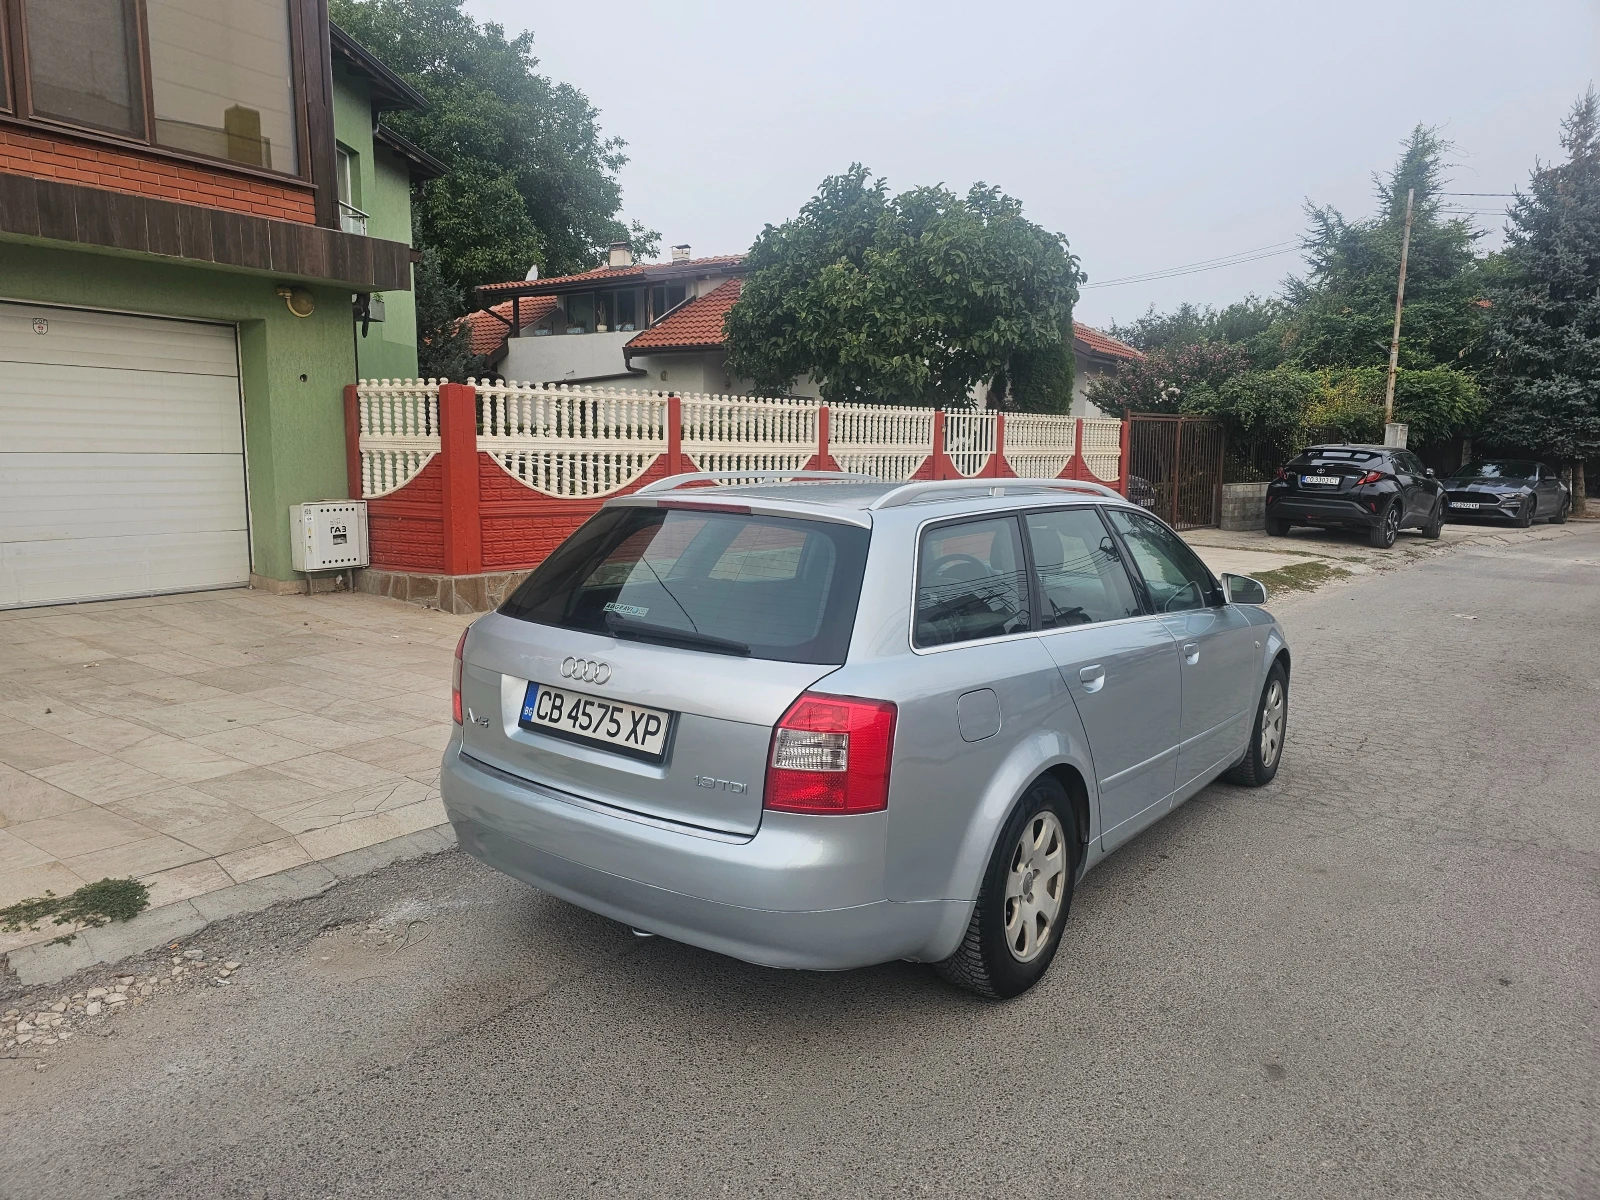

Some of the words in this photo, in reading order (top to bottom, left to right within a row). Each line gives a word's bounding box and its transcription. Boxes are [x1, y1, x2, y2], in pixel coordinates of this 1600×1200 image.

[330, 525, 346, 533] ГАЗ
[524, 706, 533, 716] BG
[536, 691, 565, 724] CB
[567, 698, 624, 738] 4575
[624, 710, 662, 745] XP
[717, 778, 748, 795] TDI
